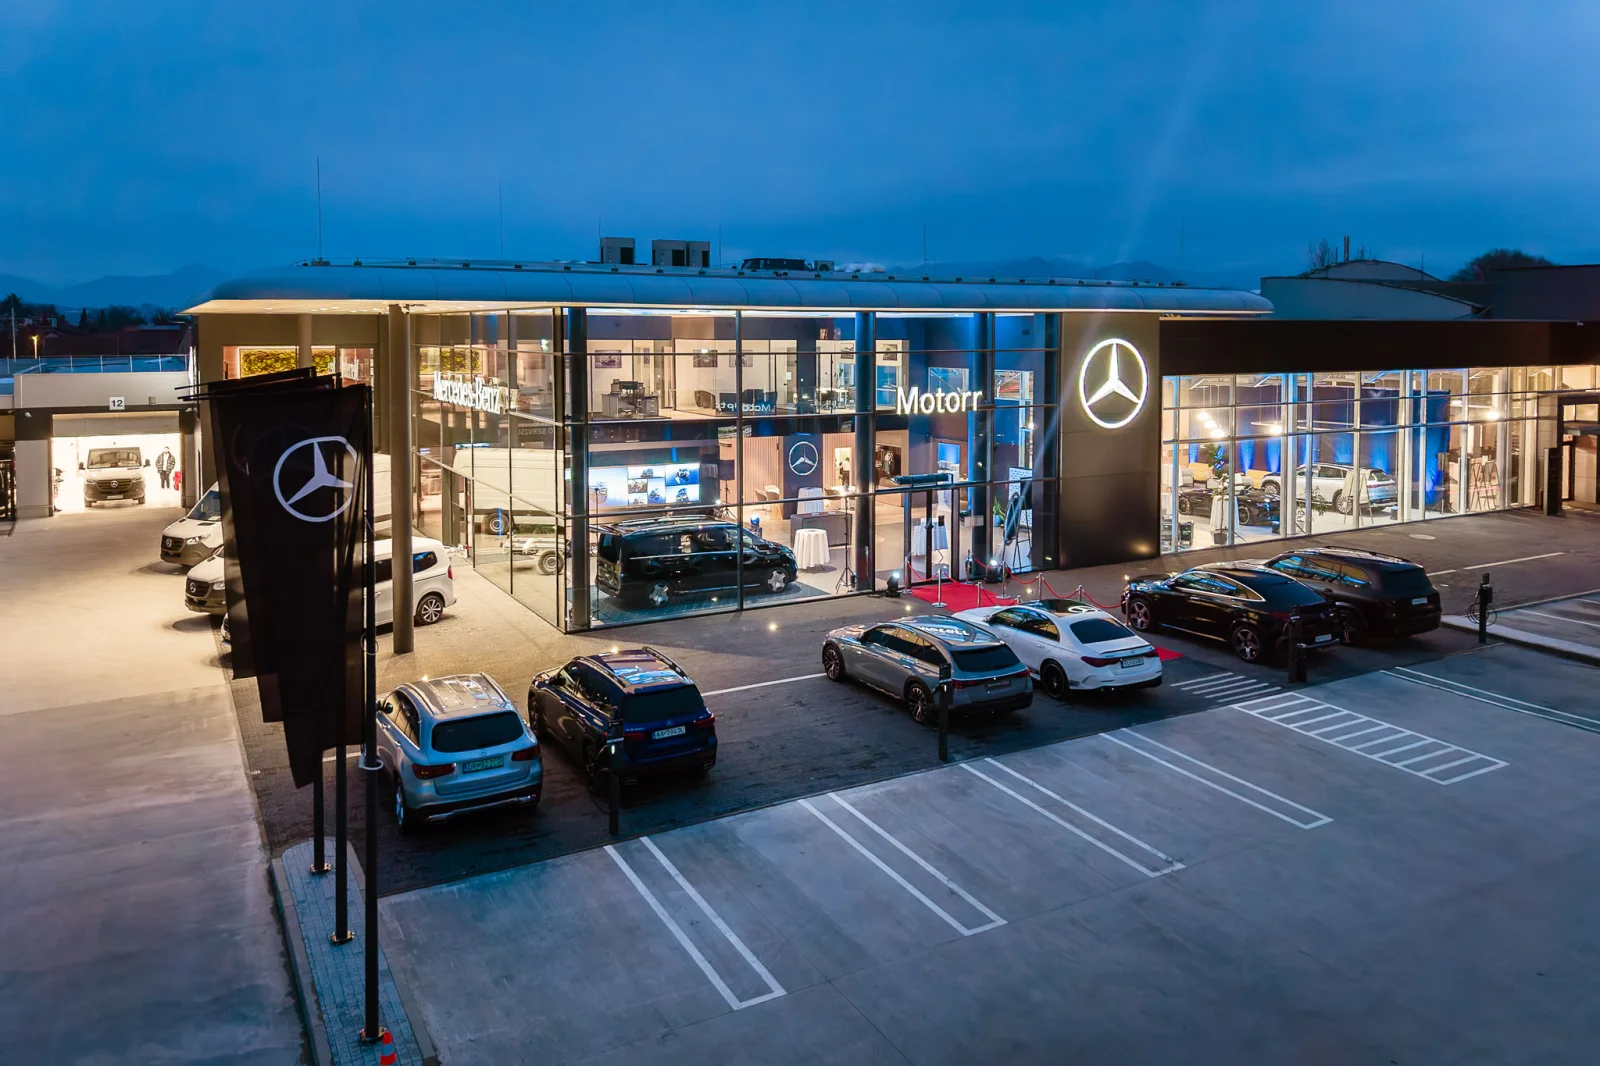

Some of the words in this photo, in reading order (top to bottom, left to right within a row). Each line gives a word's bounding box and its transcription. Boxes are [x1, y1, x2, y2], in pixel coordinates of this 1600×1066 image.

[111, 399, 123, 408] 12
[433, 371, 501, 415] Mercedes-Benz
[897, 386, 983, 415] Motorr
